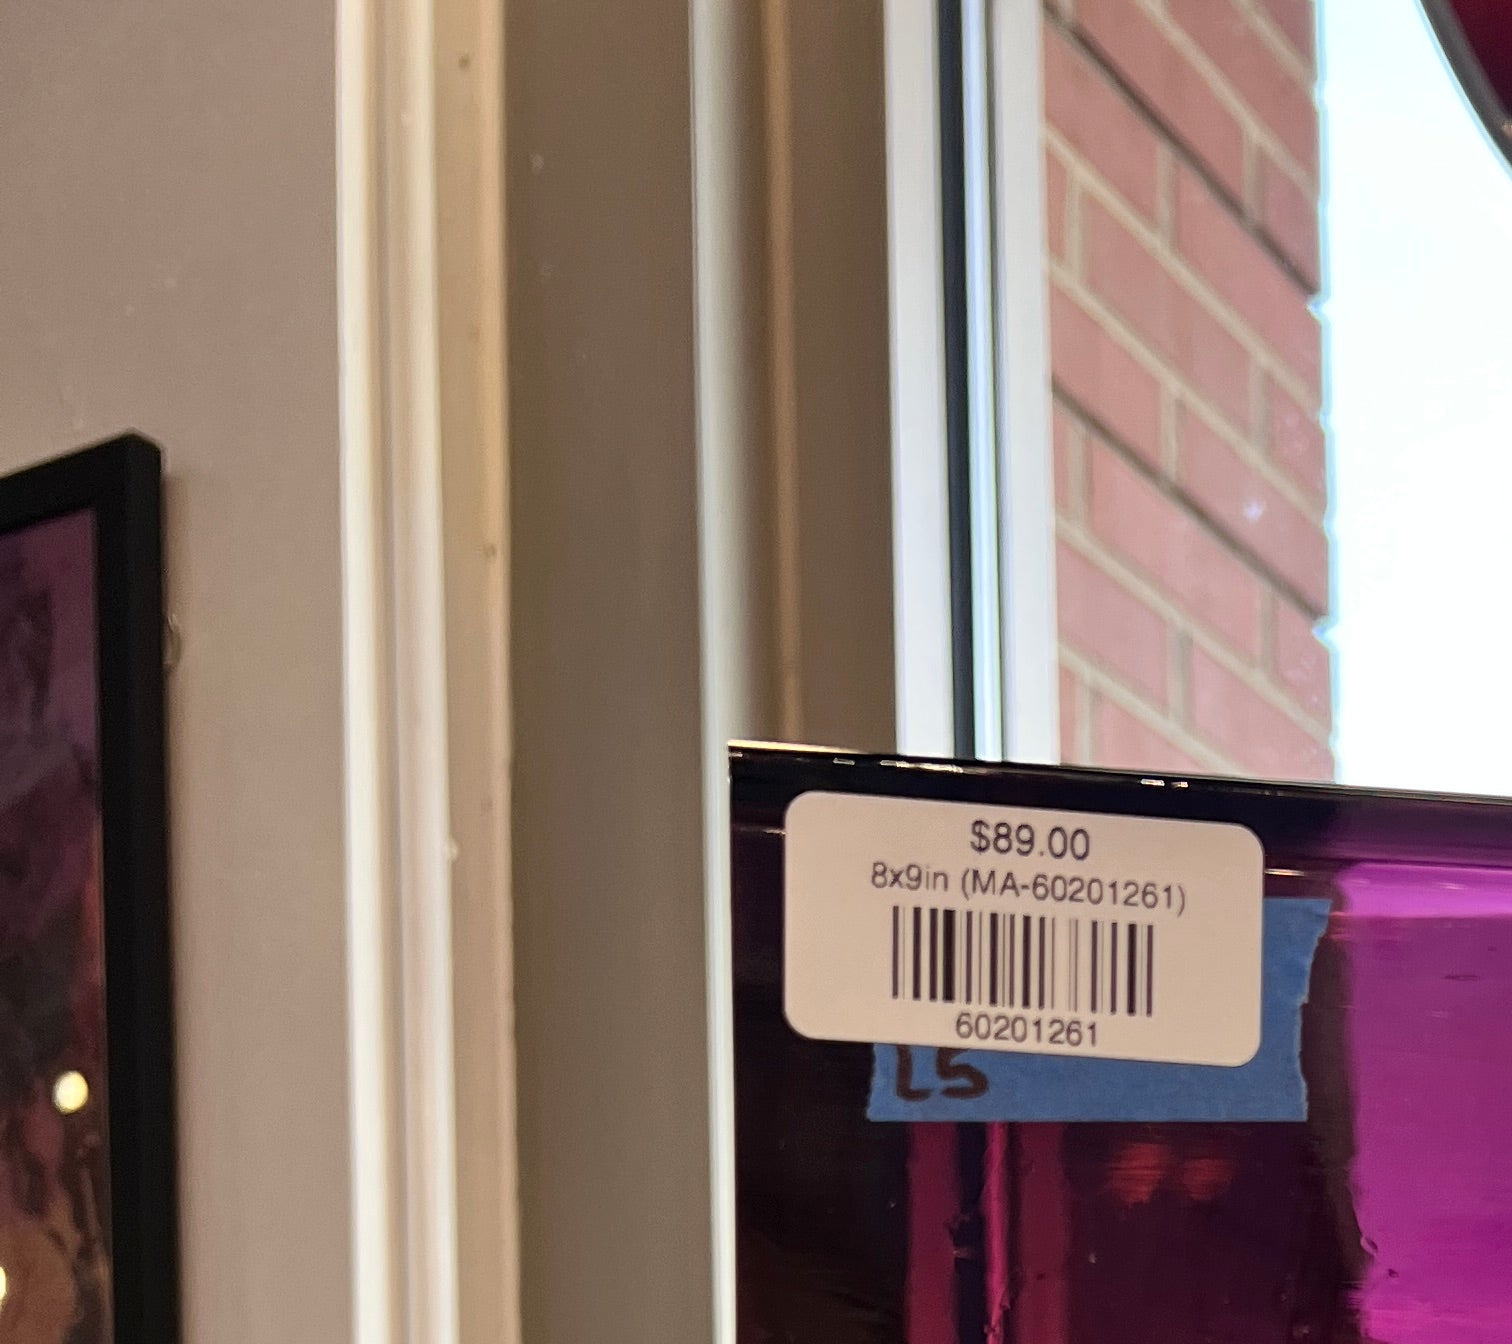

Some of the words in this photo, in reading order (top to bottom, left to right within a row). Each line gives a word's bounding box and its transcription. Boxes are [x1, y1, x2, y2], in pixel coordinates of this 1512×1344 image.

[970, 818, 1091, 861] $89.00
[870, 861, 949, 892] 8x9in
[960, 867, 1187, 917] (MA-60201261)
[955, 1012, 1098, 1048] 60201261
